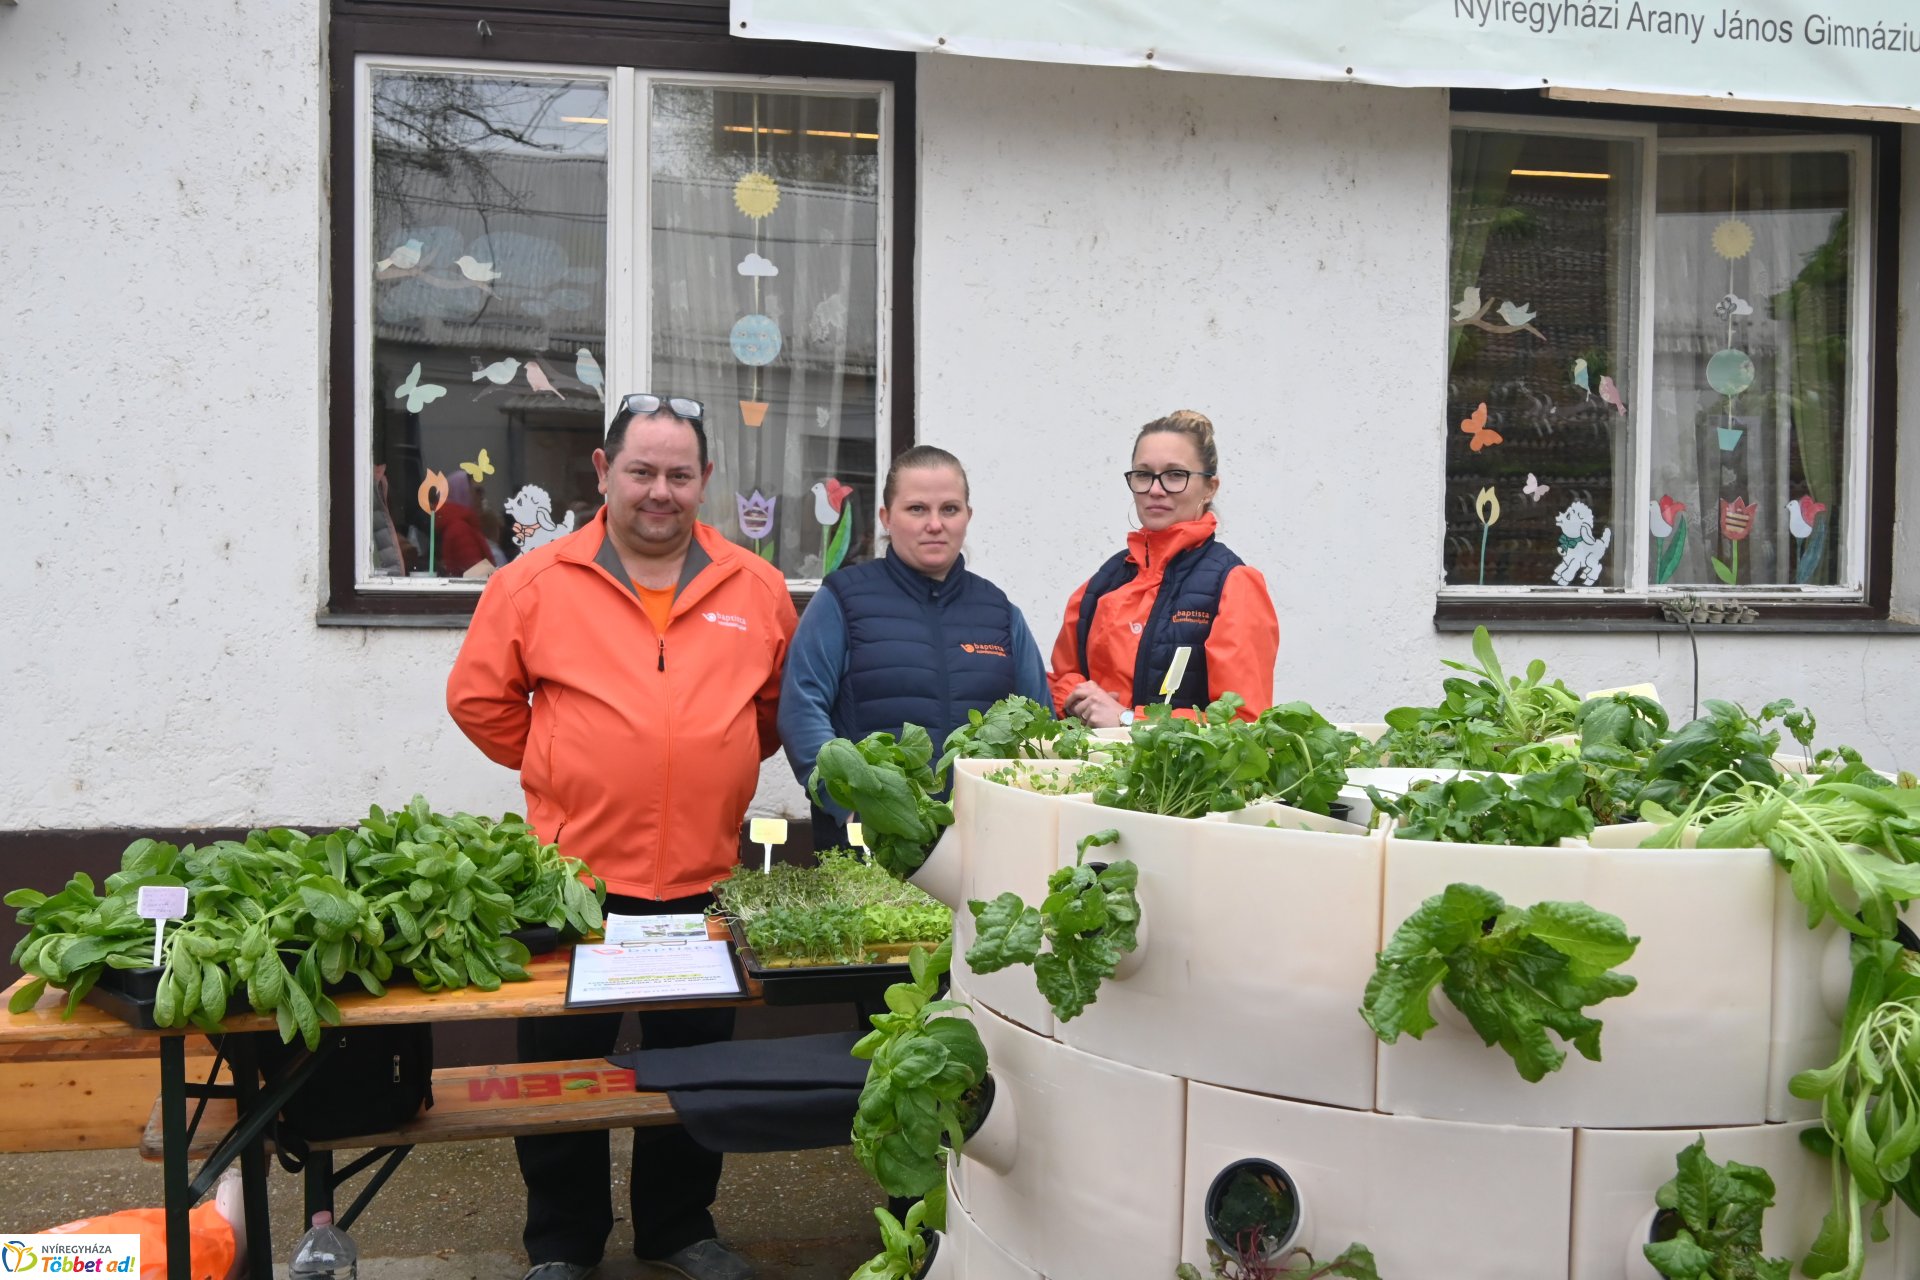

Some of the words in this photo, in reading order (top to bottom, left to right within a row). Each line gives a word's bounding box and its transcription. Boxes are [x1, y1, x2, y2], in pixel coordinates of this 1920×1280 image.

[1626, 1, 1705, 44] Arany
[1713, 9, 1793, 43] János
[1177, 610, 1210, 619] baptista
[974, 643, 1005, 652] baptista
